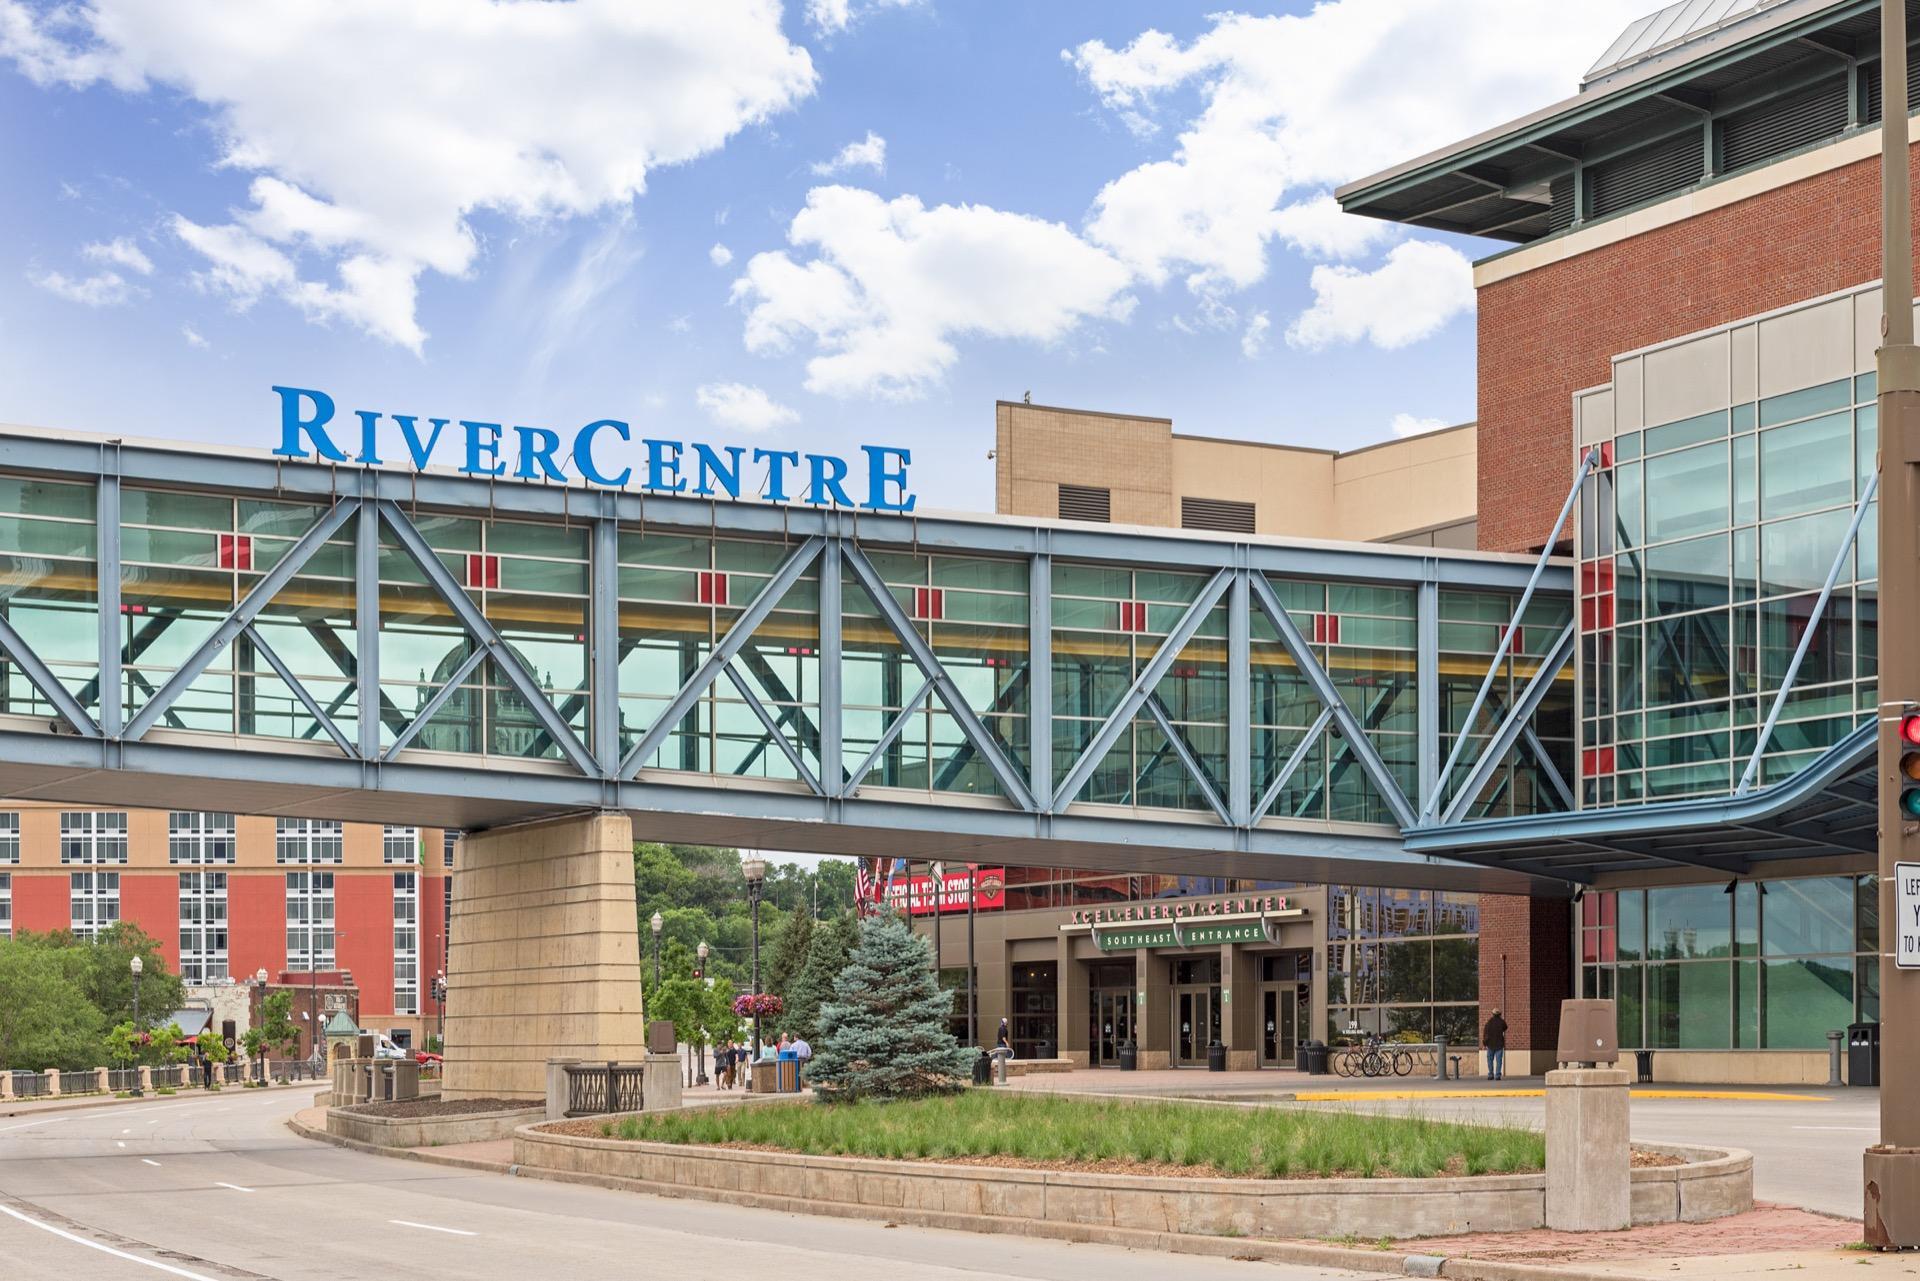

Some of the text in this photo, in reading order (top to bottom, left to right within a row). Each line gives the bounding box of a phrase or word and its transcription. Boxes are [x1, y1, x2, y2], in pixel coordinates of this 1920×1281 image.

[884, 883, 921, 908] OFFICAL
[947, 877, 976, 905] STORE
[1071, 896, 1290, 925] XCEL ENERGY CENTER
[1107, 928, 1259, 945] SOUTHEAST ENTRANCE
[1903, 935, 1914, 953] TO
